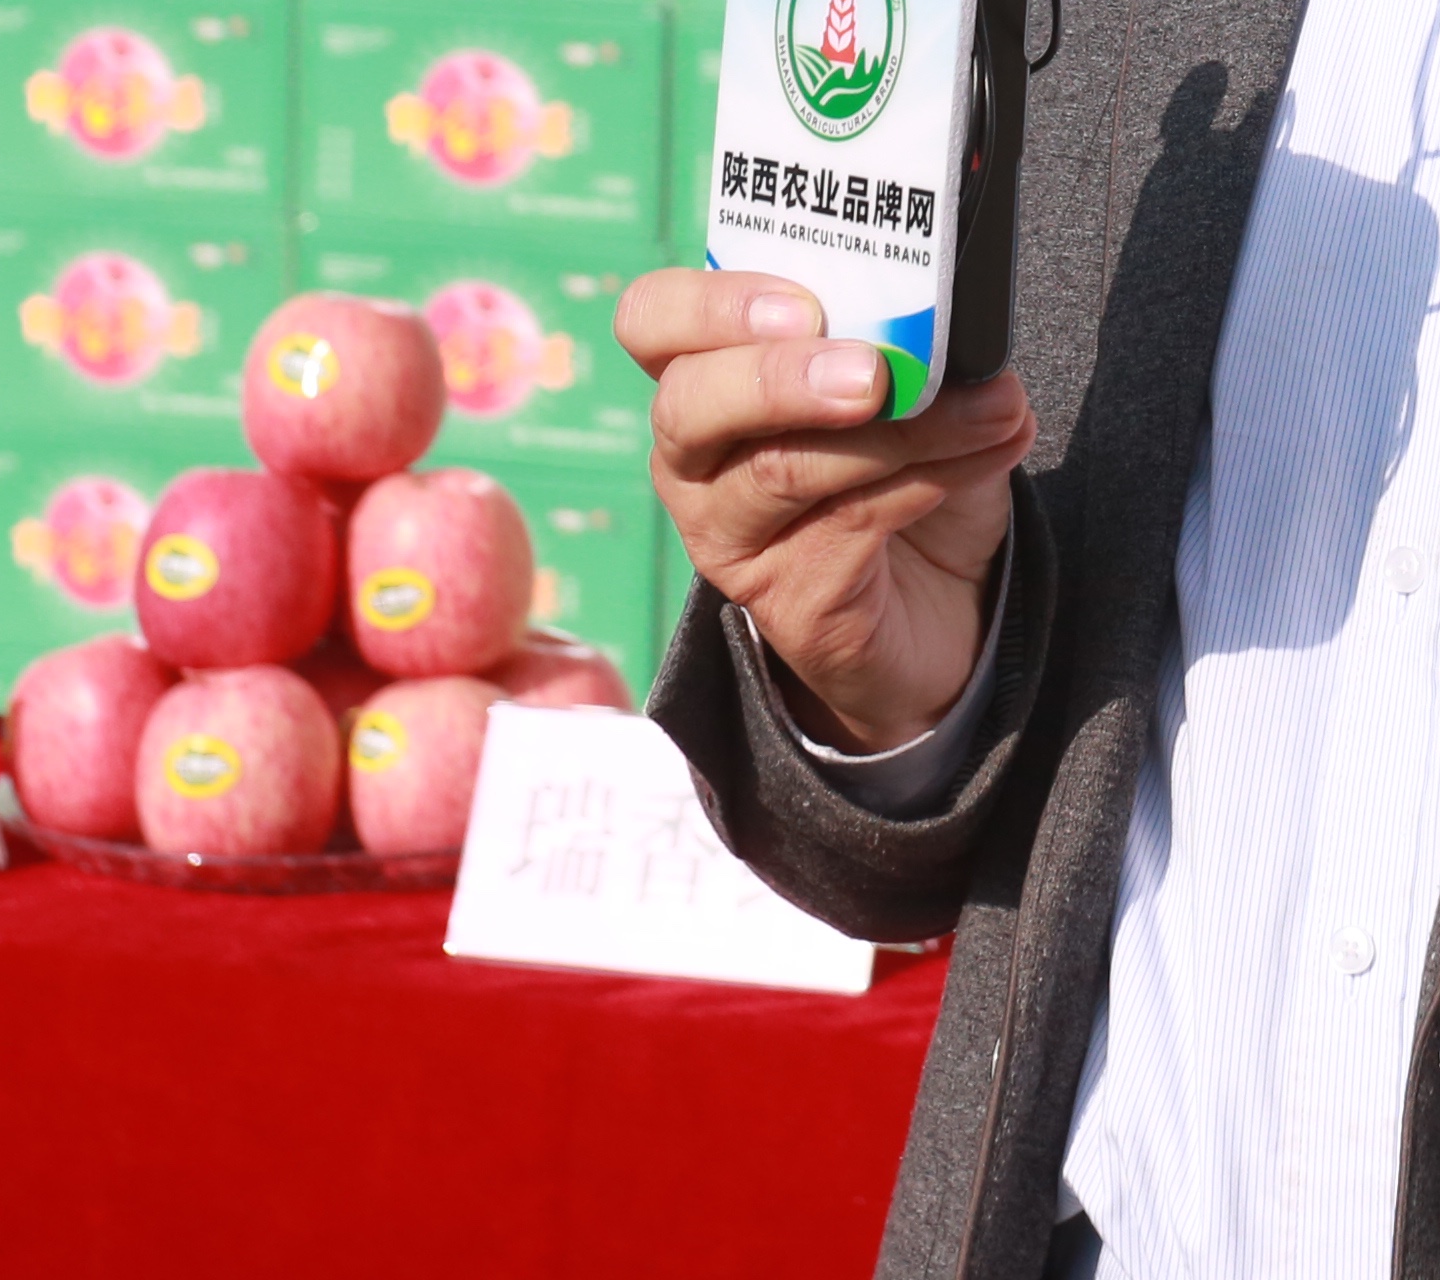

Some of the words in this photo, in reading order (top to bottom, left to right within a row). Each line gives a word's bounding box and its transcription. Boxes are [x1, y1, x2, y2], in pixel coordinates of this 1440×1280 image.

[778, 34, 800, 103] SHAANXI
[800, 106, 873, 135] AGRICULTURAL
[874, 55, 898, 106] BRAND
[718, 209, 775, 235] SHAANXI
[779, 221, 878, 257] AGRICULTURAL
[883, 242, 931, 267] BRAND
[721, 151, 936, 238] 陕西农业品牌网
[510, 777, 765, 908] 瑞香
